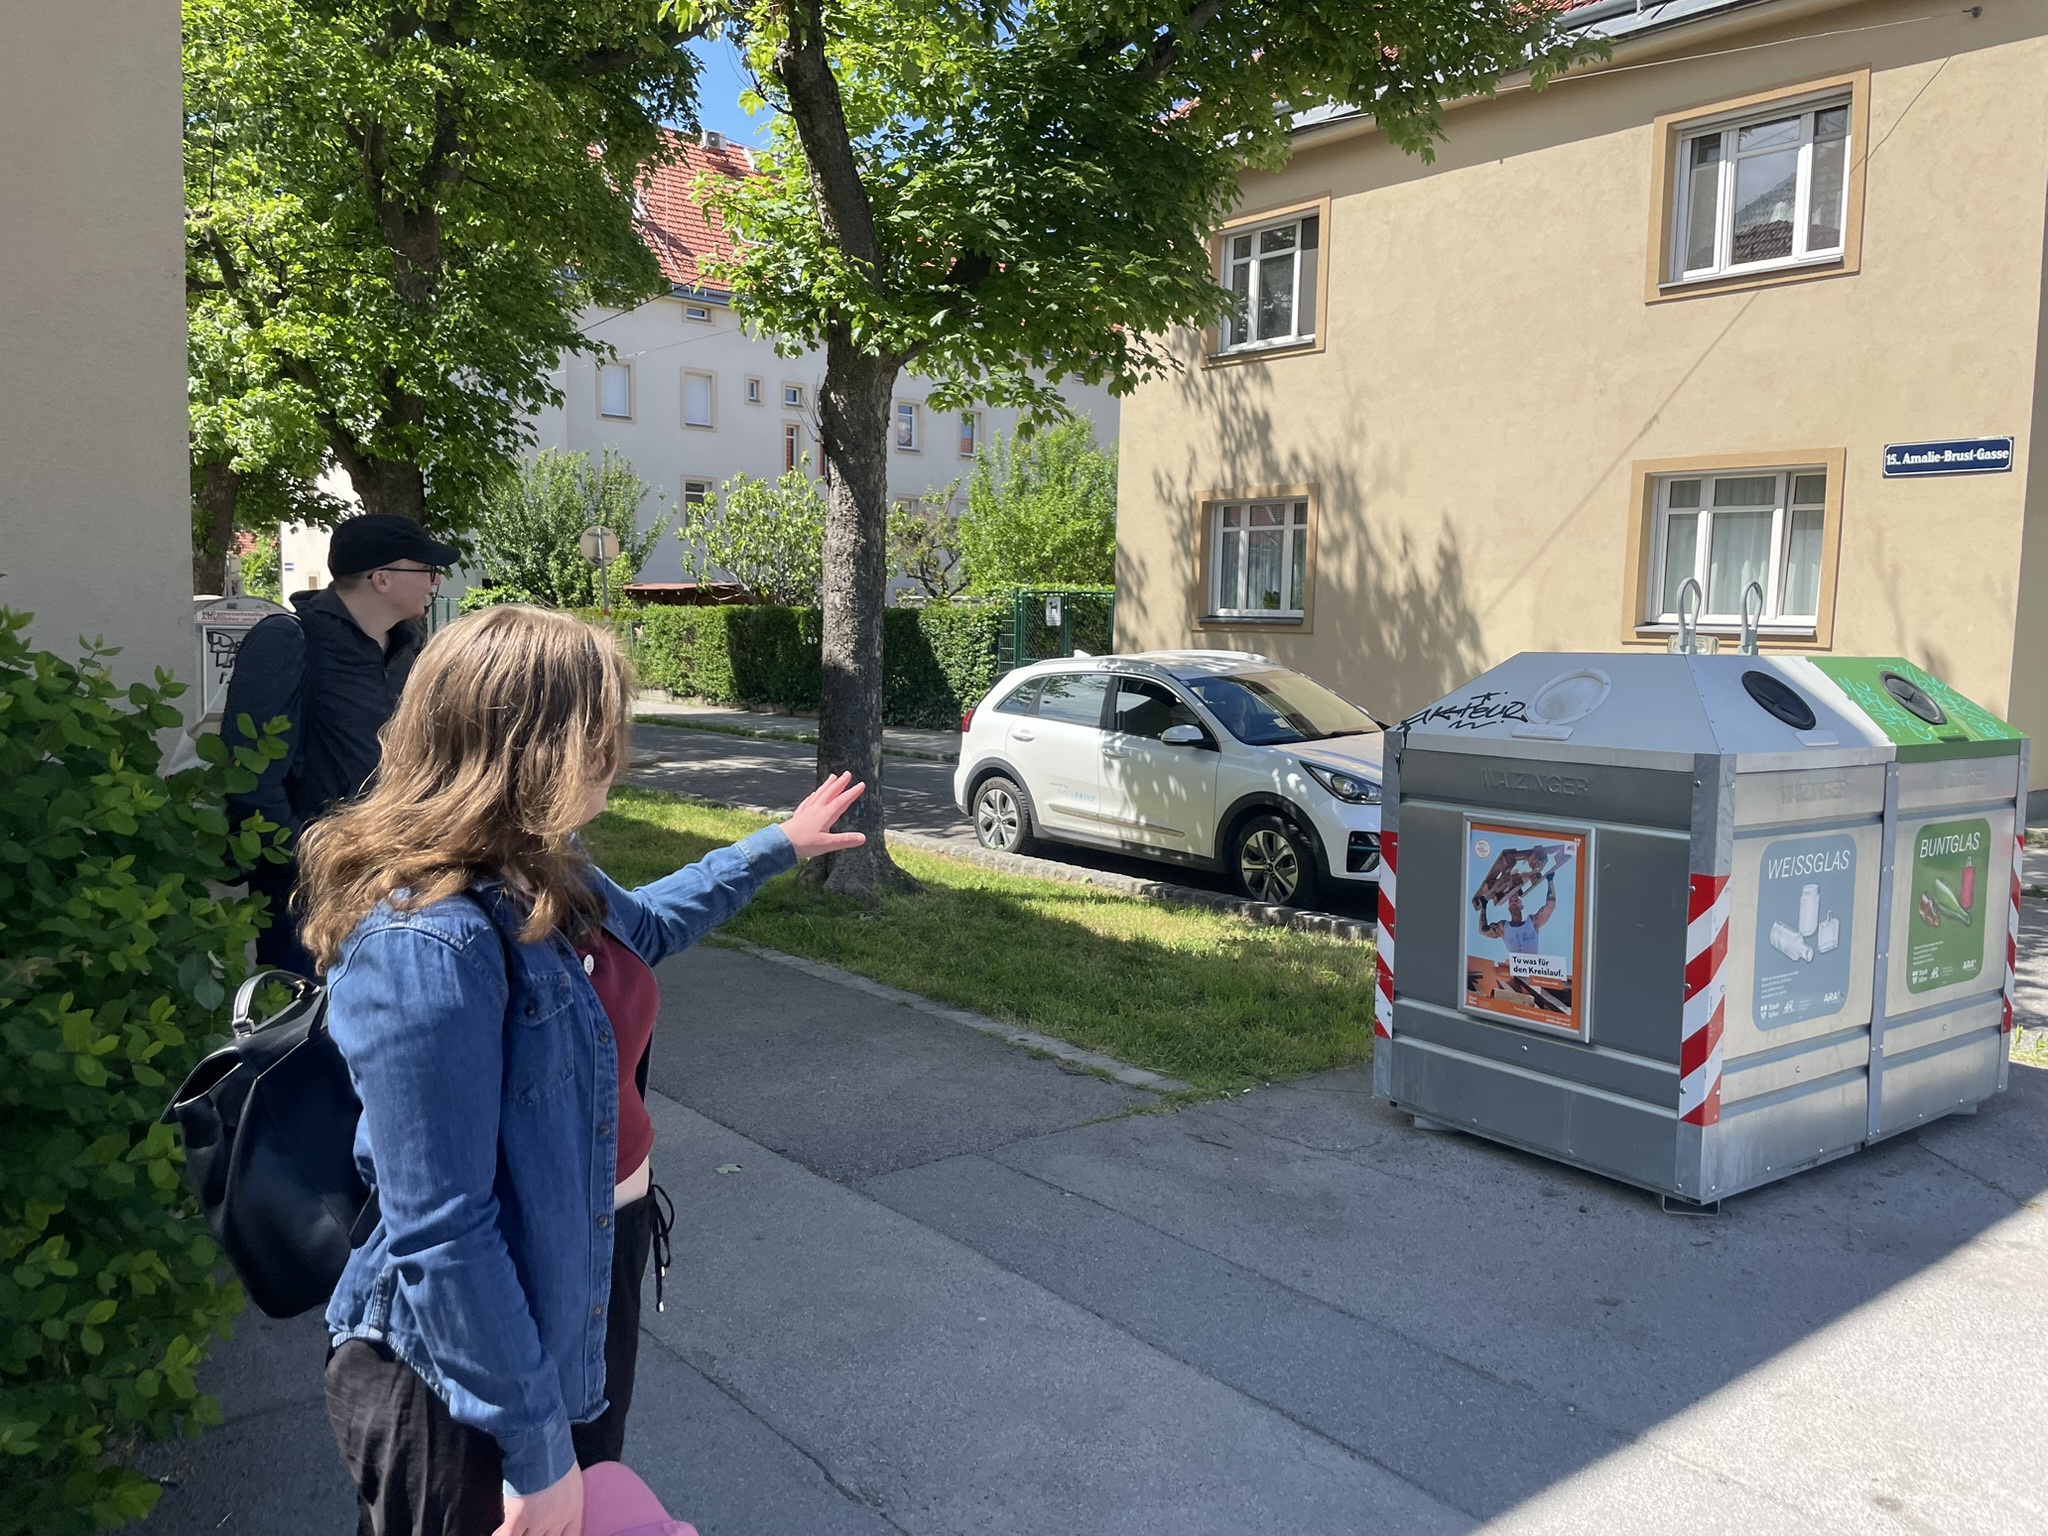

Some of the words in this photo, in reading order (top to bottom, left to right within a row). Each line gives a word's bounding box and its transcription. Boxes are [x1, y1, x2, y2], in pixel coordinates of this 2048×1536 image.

[1902, 447, 2009, 464] Amalie-Brust-Gasse
[1920, 831, 1981, 858] BUNTGLAS
[1768, 849, 1851, 880] WEISSGLAS
[1512, 956, 1521, 964] Tu
[1538, 957, 1549, 966] für
[1513, 965, 1527, 973] den
[1529, 966, 1564, 977] Kreislauf.
